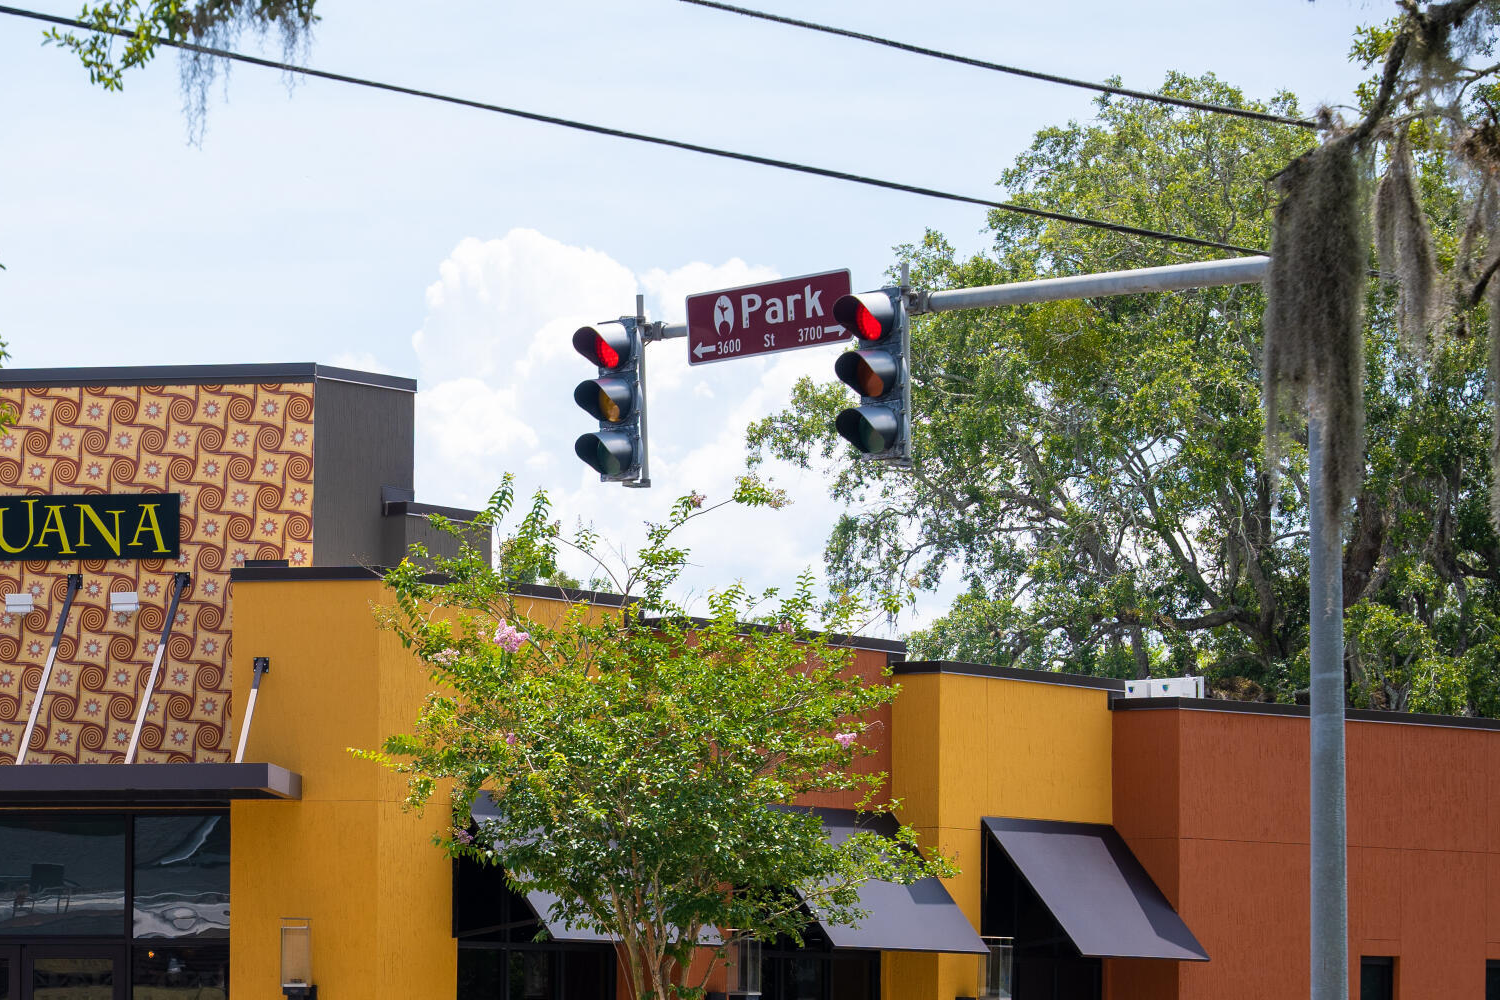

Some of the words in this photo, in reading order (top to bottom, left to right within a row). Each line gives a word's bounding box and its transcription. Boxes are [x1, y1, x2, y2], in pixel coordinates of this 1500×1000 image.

[741, 284, 824, 329] Park
[717, 338, 741, 355] 3600
[763, 332, 776, 348] St
[798, 325, 823, 343] 3700
